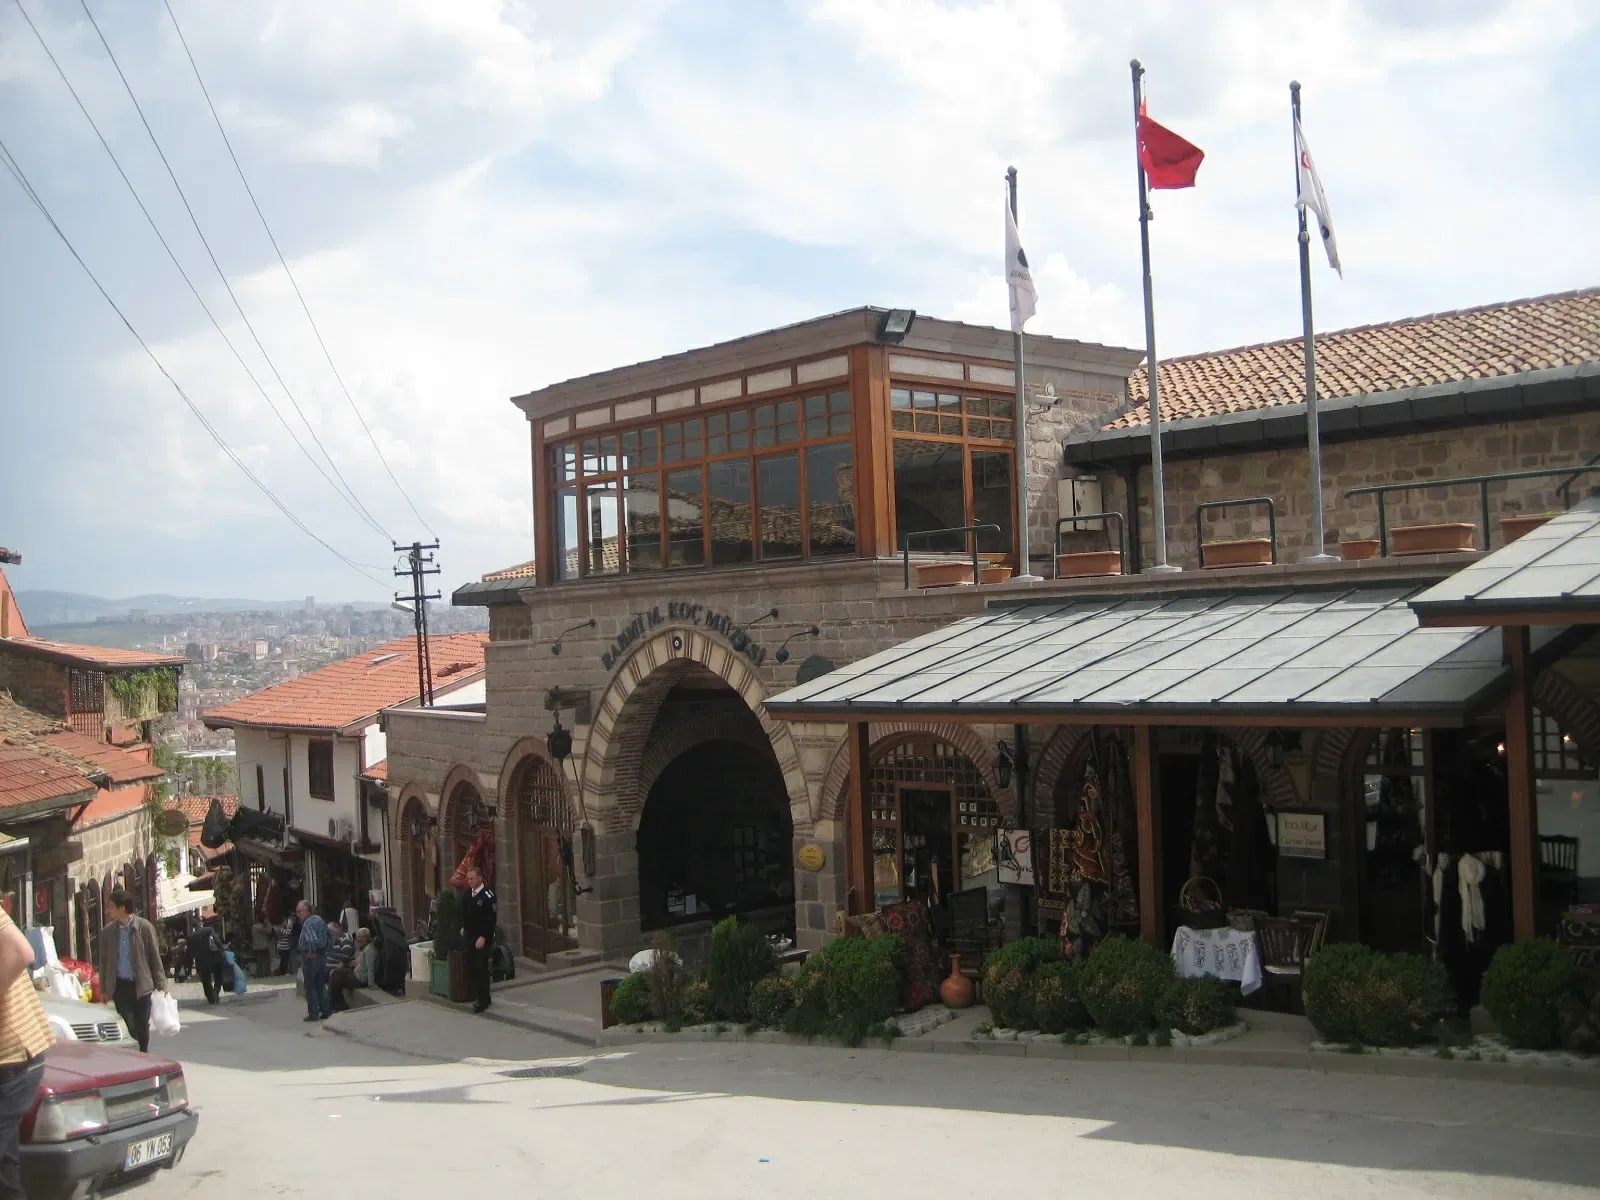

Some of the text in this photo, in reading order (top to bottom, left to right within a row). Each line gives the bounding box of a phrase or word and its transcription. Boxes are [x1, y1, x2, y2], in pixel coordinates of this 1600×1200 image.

[667, 602, 704, 626] KOÇ
[131, 1144, 142, 1164] 06
[147, 1140, 156, 1159] YN
